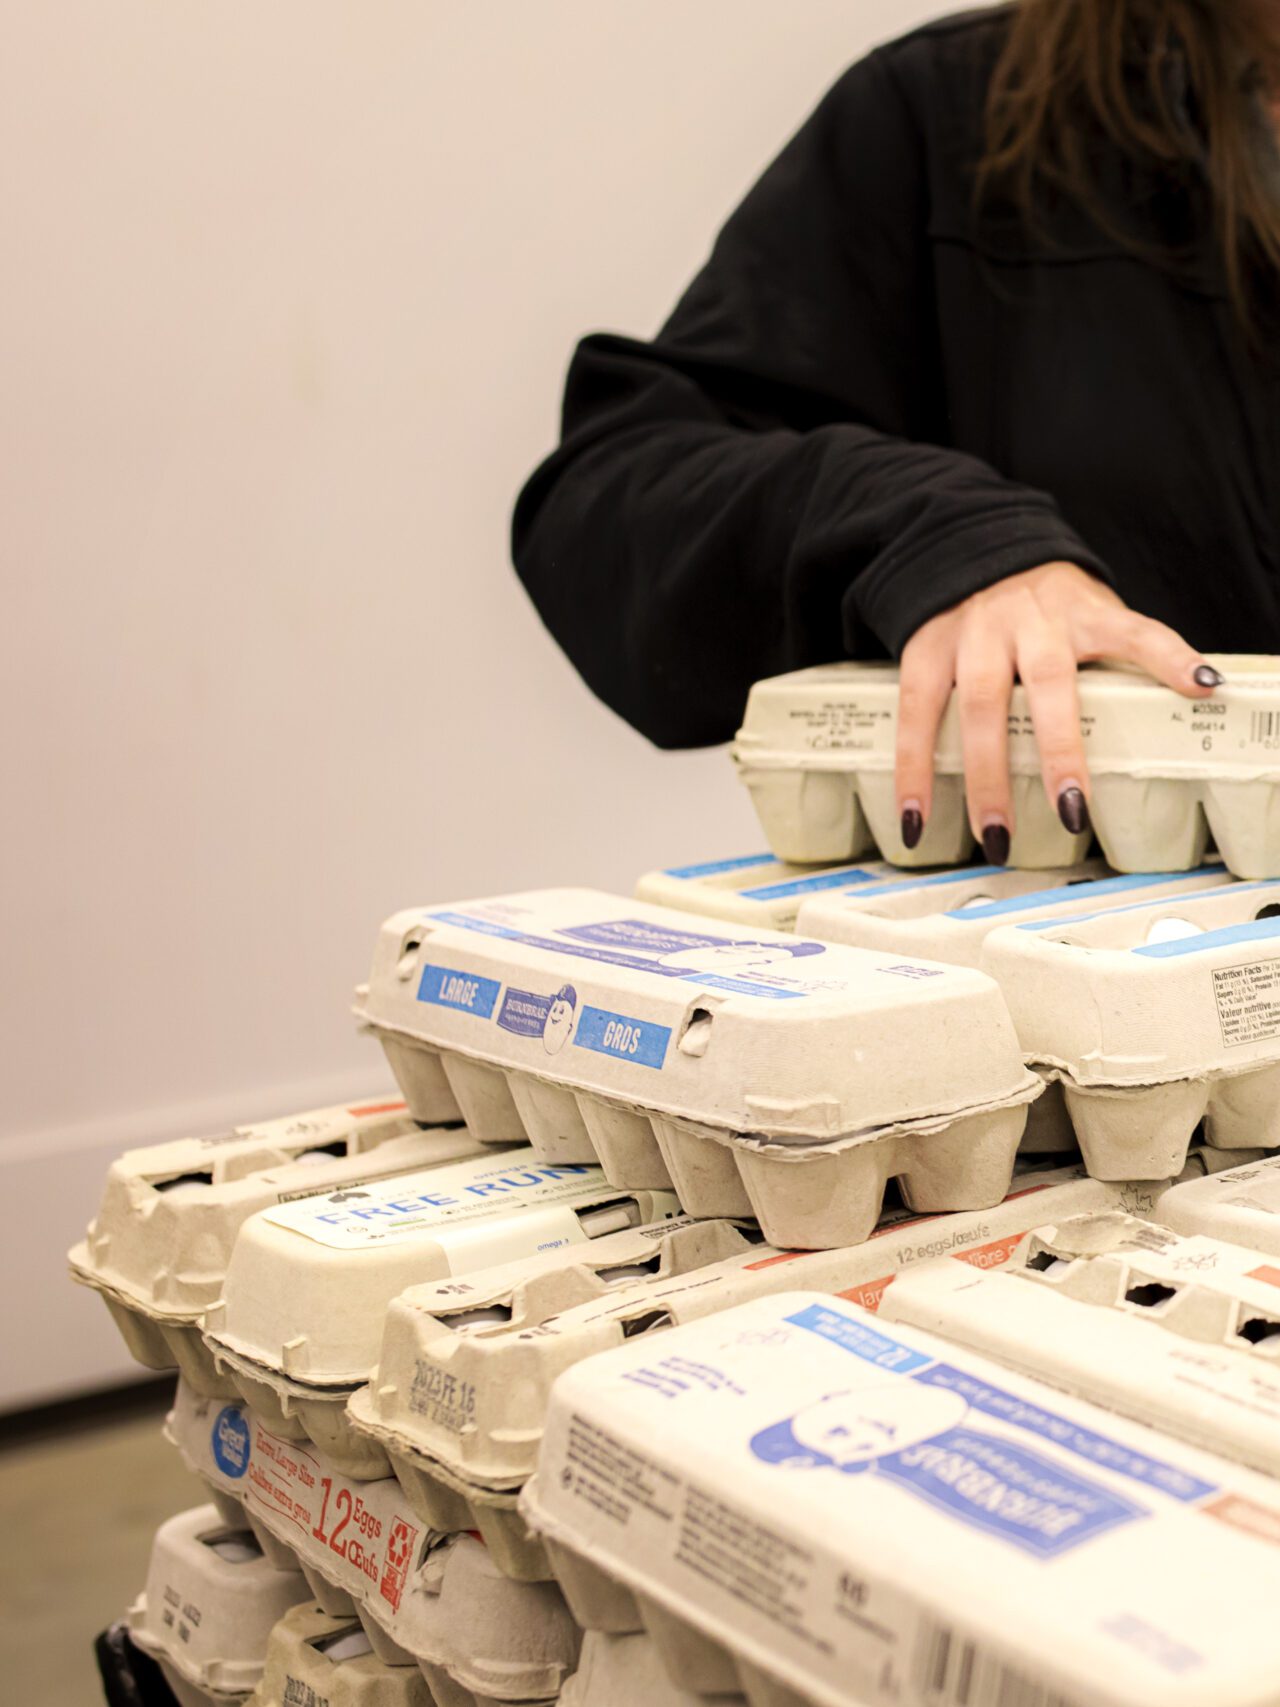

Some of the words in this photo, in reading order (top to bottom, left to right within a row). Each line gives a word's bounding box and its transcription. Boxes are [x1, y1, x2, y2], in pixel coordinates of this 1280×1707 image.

[1202, 736, 1212, 751] 6
[1214, 970, 1242, 981] Nutrition
[1244, 965, 1262, 977] Facts
[439, 973, 479, 1008] LARGE
[1220, 1007, 1242, 1019] Valeur
[1244, 1002, 1271, 1014] nutritive
[603, 1021, 641, 1054] GROS
[316, 1191, 460, 1225] FREE
[463, 1165, 592, 1196] RUN
[537, 1240, 562, 1251] omega
[896, 1248, 914, 1265] 12
[460, 1382, 476, 1412] 16
[219, 1416, 246, 1454] Great
[256, 1431, 276, 1461] Extra
[275, 1446, 299, 1478] Large
[300, 1464, 316, 1489] Size
[249, 1462, 273, 1496] Calibre
[273, 1486, 293, 1511] extra
[292, 1503, 312, 1525] gros
[312, 1478, 353, 1558] 12
[353, 1498, 382, 1539] Eggs
[348, 1540, 379, 1583] Œufs
